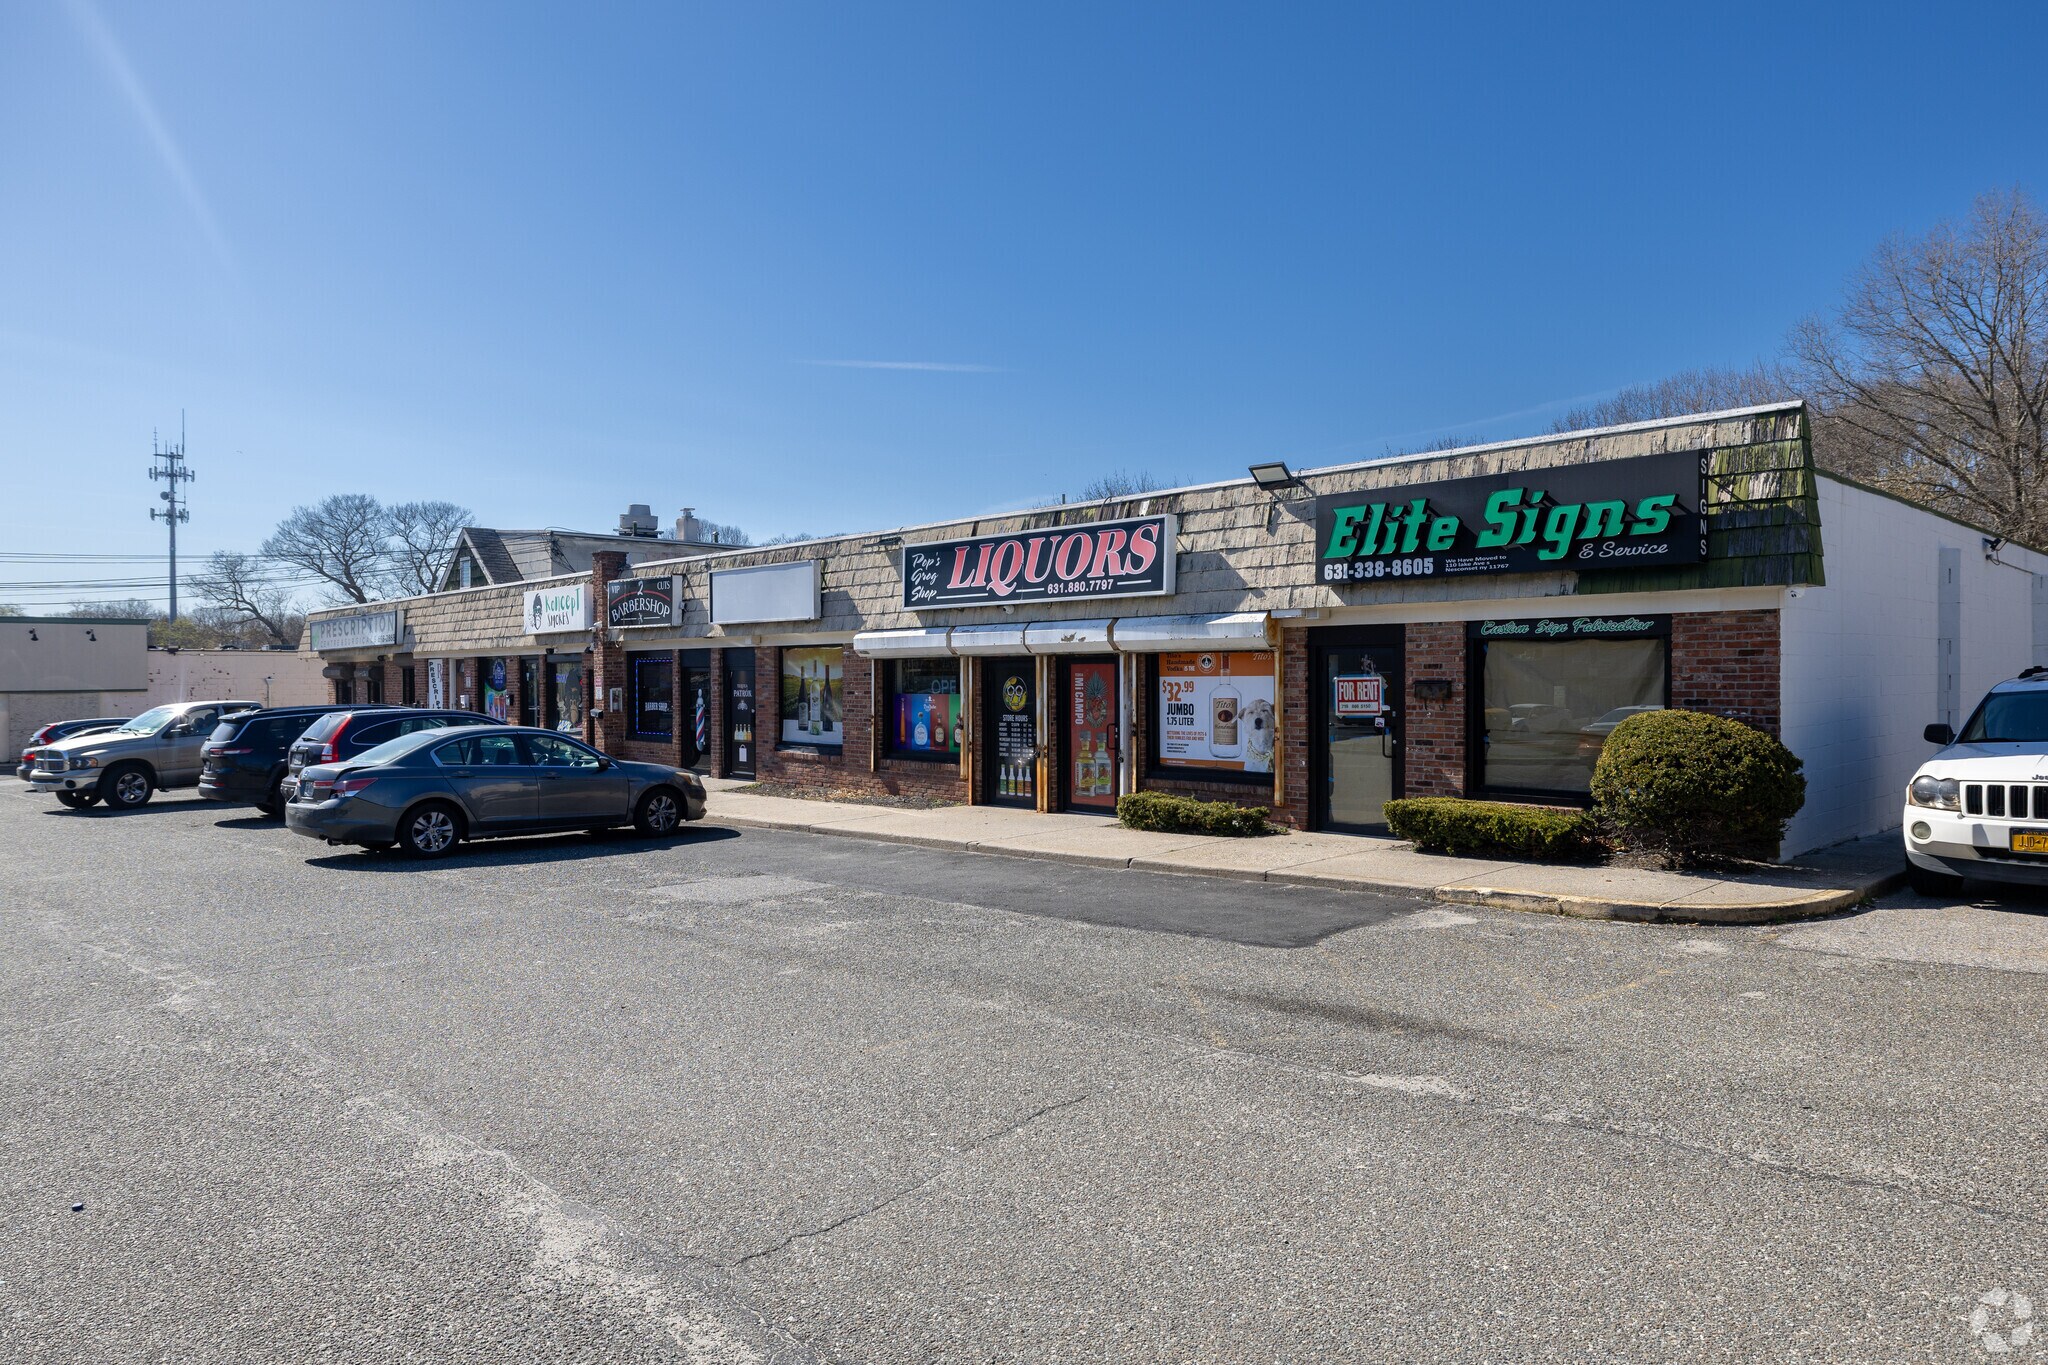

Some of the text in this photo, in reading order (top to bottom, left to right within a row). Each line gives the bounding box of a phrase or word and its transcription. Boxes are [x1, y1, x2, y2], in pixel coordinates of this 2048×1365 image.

[1699, 458, 1708, 556] SIGNS
[1322, 486, 1679, 562] Elite Signs
[947, 523, 1161, 597] LIQUORS
[1579, 541, 1669, 559] & Service
[912, 552, 941, 570] Pop's
[1324, 558, 1434, 581] 631-338-8605
[911, 568, 939, 585] Grog
[1047, 578, 1114, 595] 631.880.7797
[611, 580, 671, 596] VIP 2 CUTS
[911, 586, 938, 601] Shop
[611, 597, 671, 623] BARBERSHOP
[320, 615, 395, 639] PRESCRIPTION
[1480, 616, 1654, 636] Custom Sign Fabrication
[931, 680, 957, 694] OPE
[1162, 680, 1195, 702] $32.99
[1339, 681, 1379, 701] FOR RENT
[1075, 691, 1084, 725] CAMPO
[1167, 703, 1194, 716] JUMBO
[1167, 717, 1194, 726] 1.75 LITER
